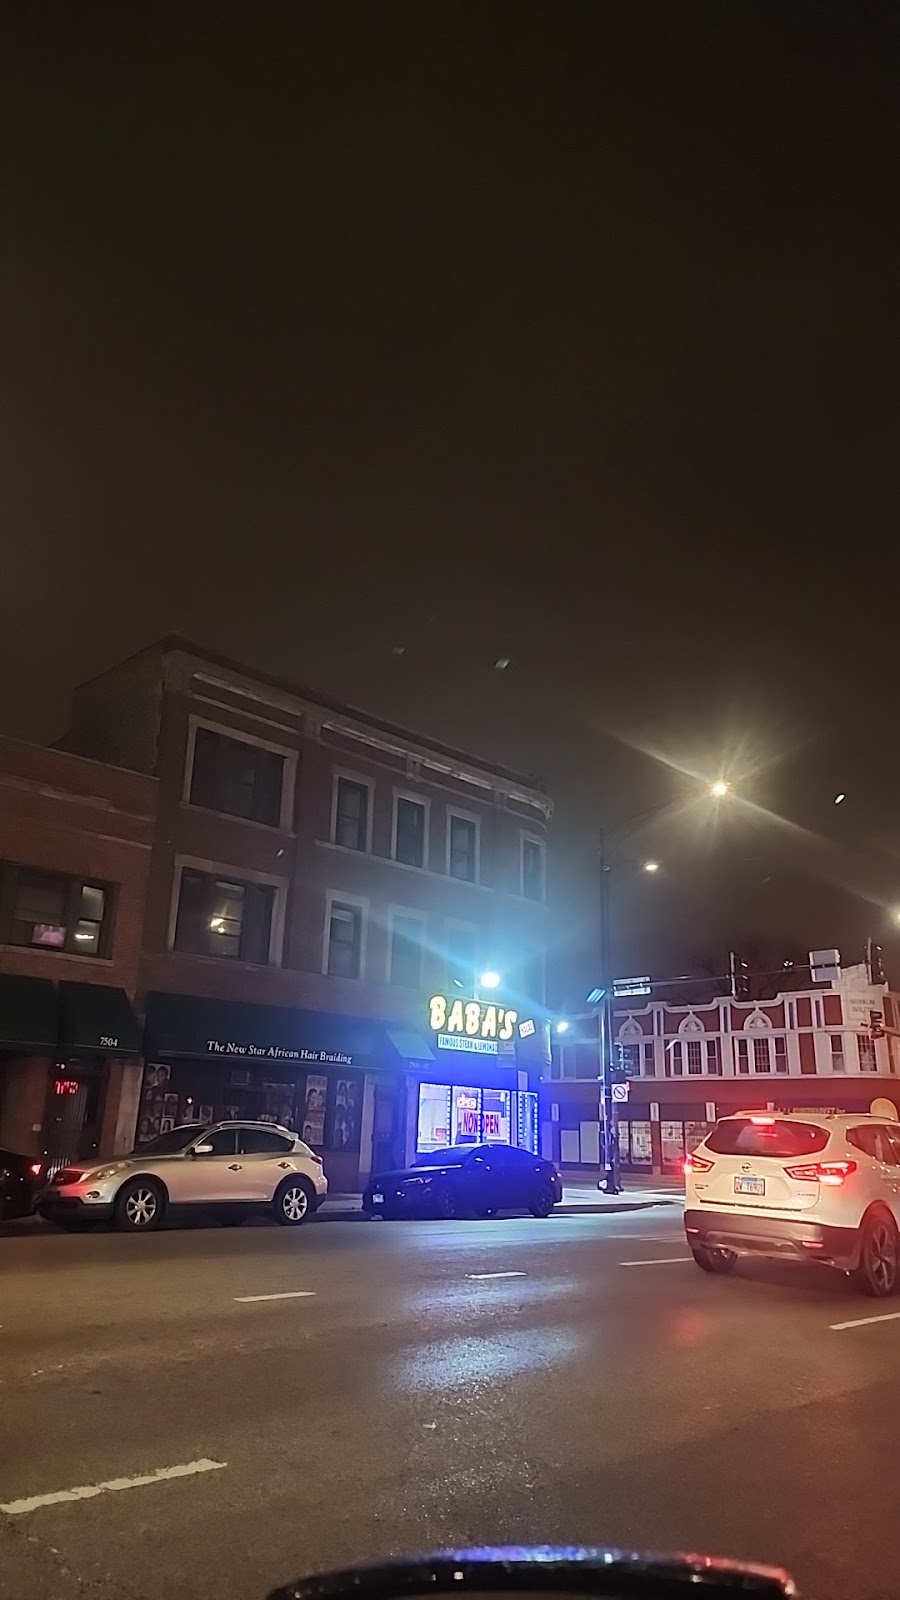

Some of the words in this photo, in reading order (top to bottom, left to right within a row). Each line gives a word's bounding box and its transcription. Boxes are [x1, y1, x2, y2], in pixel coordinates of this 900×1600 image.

[430, 996, 518, 1040] BABA'S
[100, 1037, 118, 1047] 7504
[207, 1040, 225, 1053] The
[226, 1042, 247, 1054] New
[248, 1044, 267, 1056] Star
[267, 1046, 299, 1059] African
[300, 1049, 319, 1060] Hair
[320, 1051, 352, 1064] Braiding
[439, 1036, 459, 1048] FAMOUS
[459, 1038, 473, 1049] STEAK
[473, 1042, 478, 1050] &
[481, 1114, 499, 1135] OPEN
